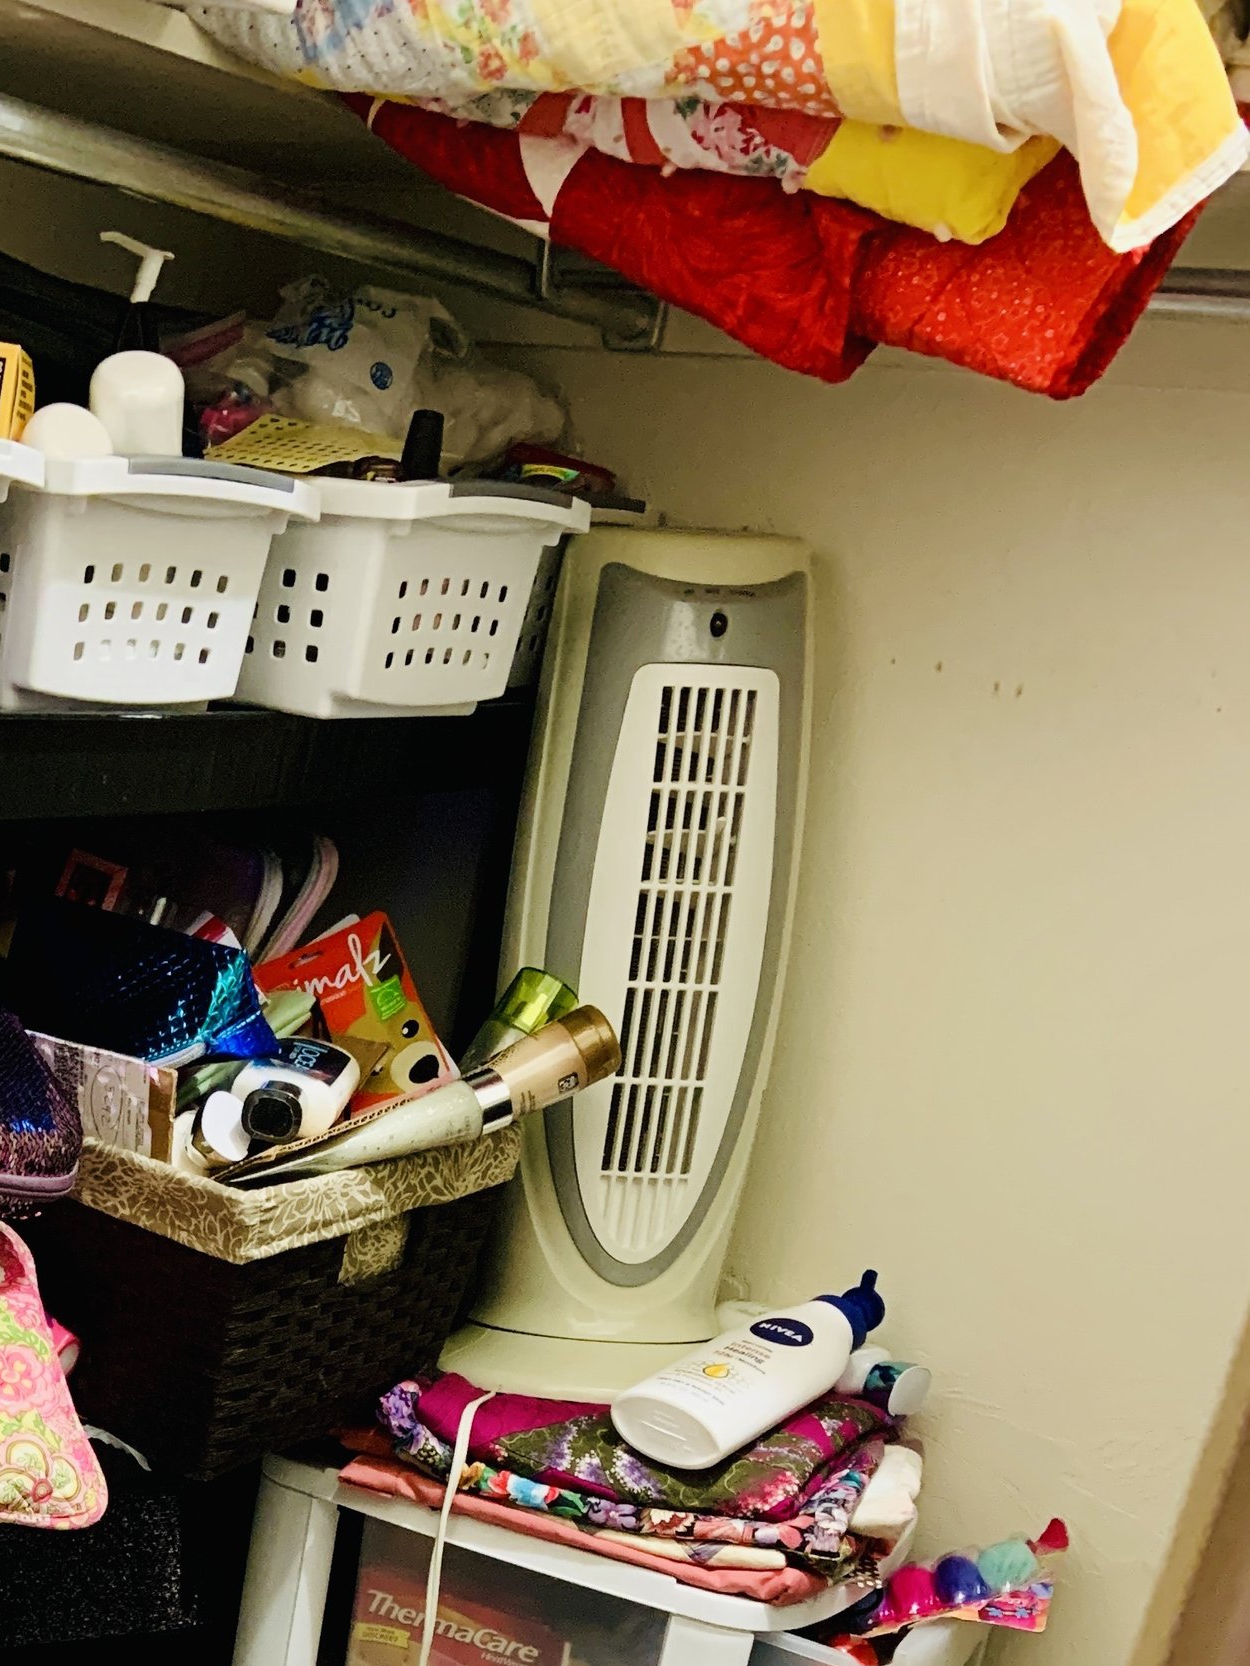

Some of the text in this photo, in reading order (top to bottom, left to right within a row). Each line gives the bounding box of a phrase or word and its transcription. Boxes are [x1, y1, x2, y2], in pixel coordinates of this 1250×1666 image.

[759, 1322, 803, 1343] NIVEA
[724, 1346, 765, 1364] Healing
[367, 1589, 539, 1663] ThermaCare
